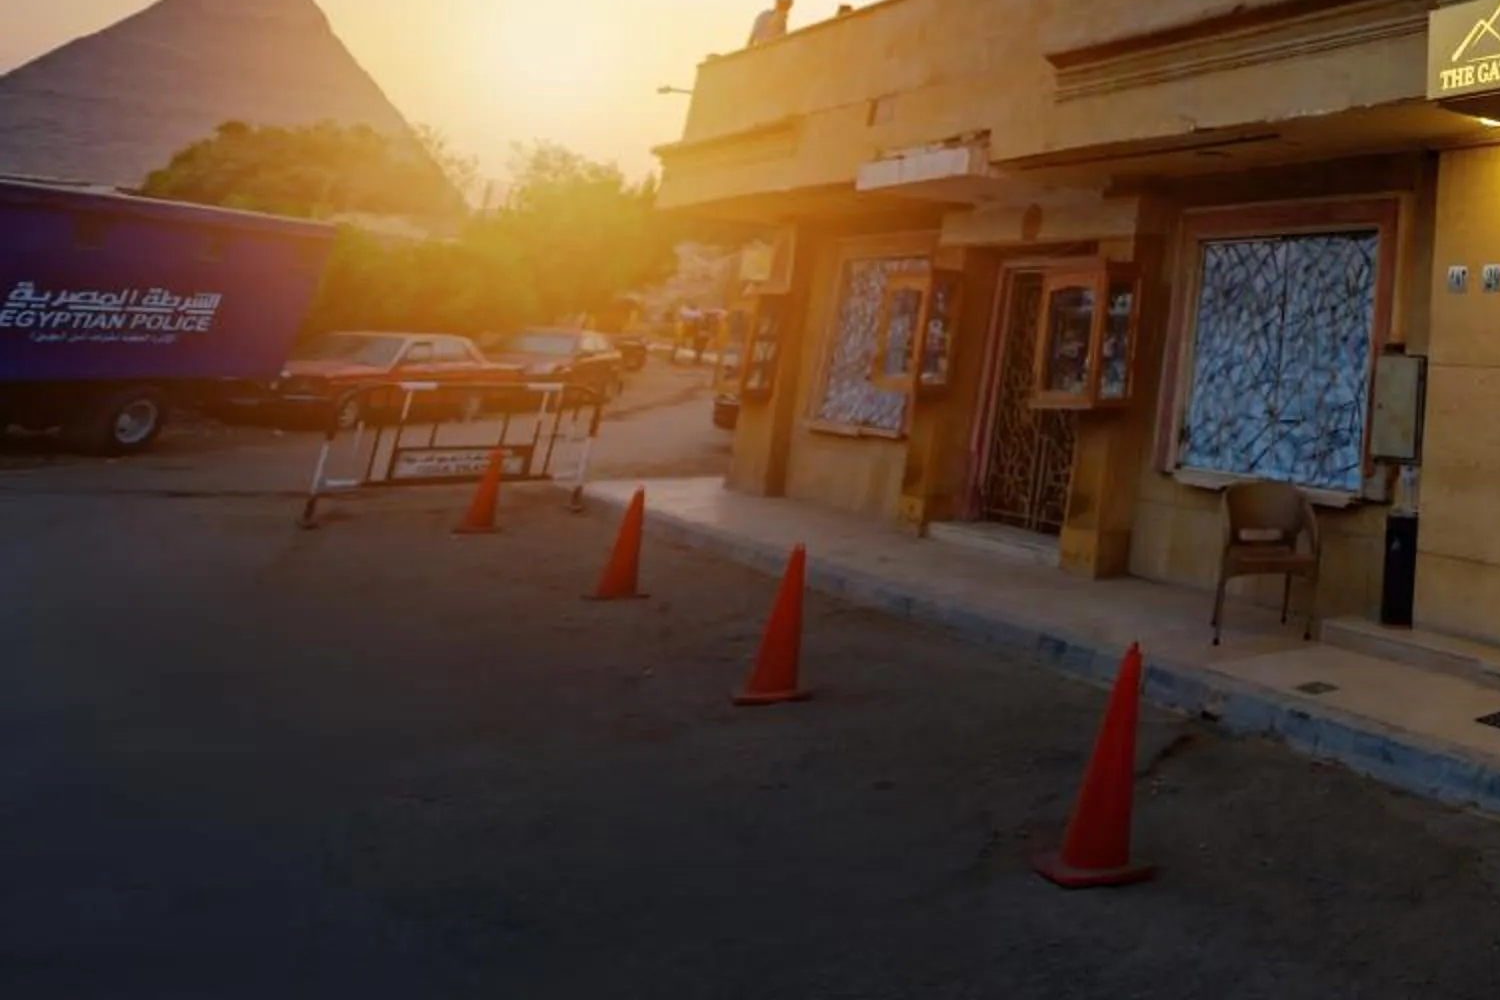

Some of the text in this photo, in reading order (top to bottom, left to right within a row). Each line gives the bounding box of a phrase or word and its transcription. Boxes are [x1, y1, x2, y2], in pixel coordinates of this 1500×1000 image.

[1440, 65, 1475, 91] THE
[5, 281, 222, 313] الشرطة المصرية
[0, 309, 213, 332] EGYPTIAN POLICE
